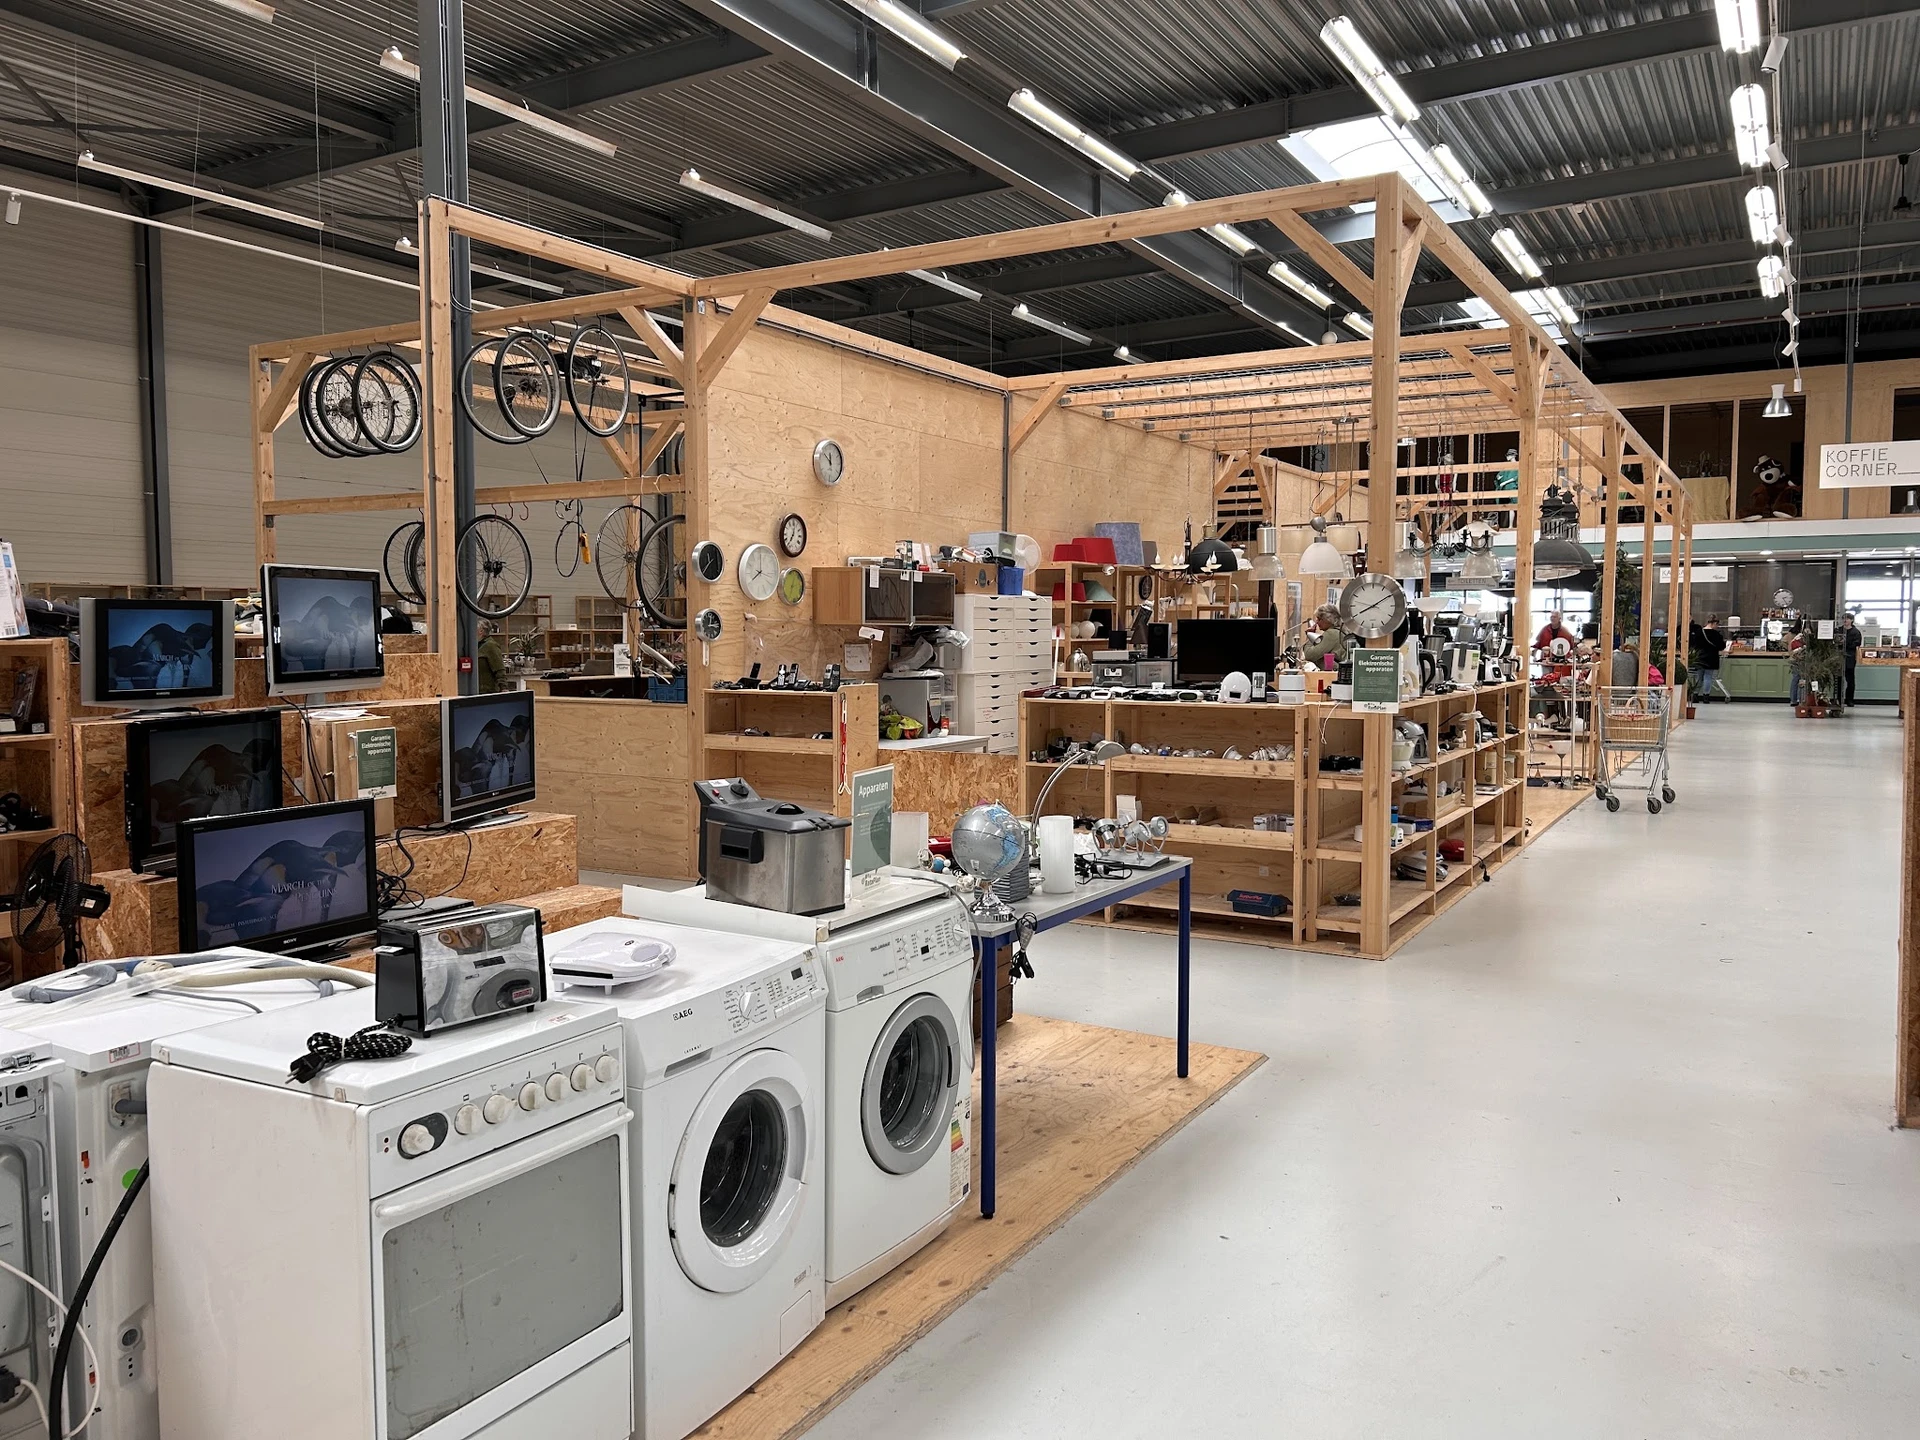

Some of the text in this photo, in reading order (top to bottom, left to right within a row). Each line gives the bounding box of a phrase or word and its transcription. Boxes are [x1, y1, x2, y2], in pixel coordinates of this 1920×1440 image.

[1826, 447, 1889, 463] KOFFIE
[1825, 462, 1898, 478] CORNER
[858, 781, 889, 798] Apparaten
[271, 880, 305, 895] MARCH
[678, 1008, 693, 1019] AEG
